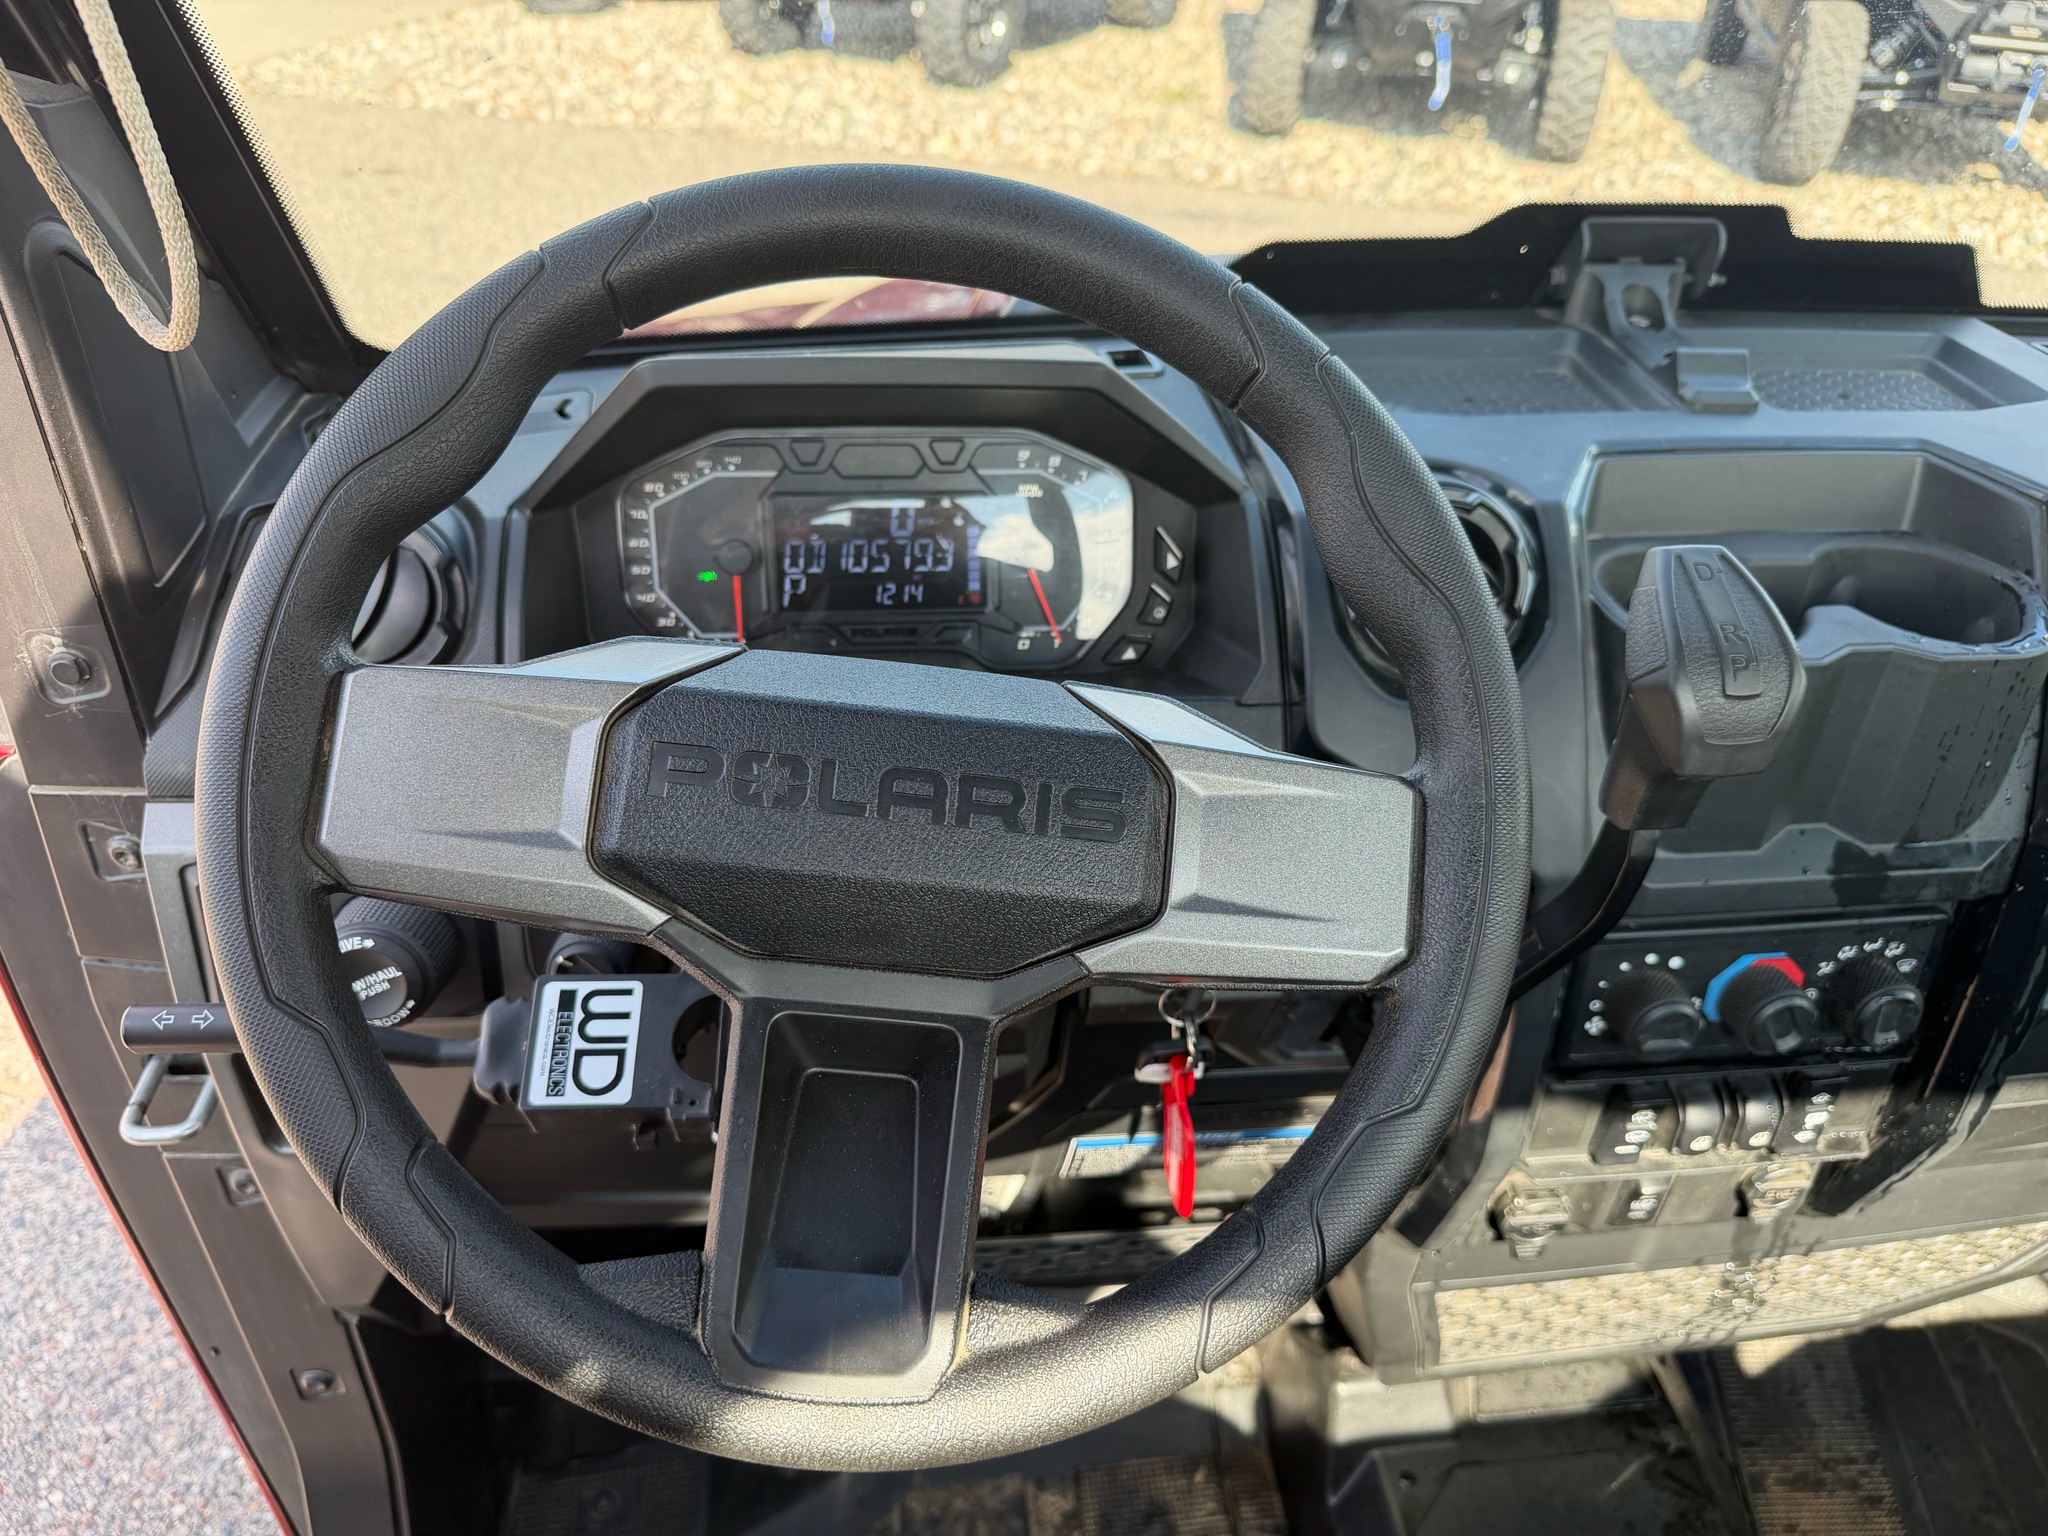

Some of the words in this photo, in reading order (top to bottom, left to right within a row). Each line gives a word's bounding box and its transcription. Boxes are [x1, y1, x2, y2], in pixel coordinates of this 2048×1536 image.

[889, 504, 915, 538] 0
[1691, 562, 1715, 582] D
[783, 574, 807, 609] P
[1715, 622, 1743, 646] R
[1727, 653, 1750, 682] P
[646, 740, 1128, 843] POLARIS
[339, 936, 363, 954] IVE
[358, 980, 391, 1001] PUSH
[548, 1011, 574, 1096] ELECTRONICS
[571, 988, 634, 1096] WD
